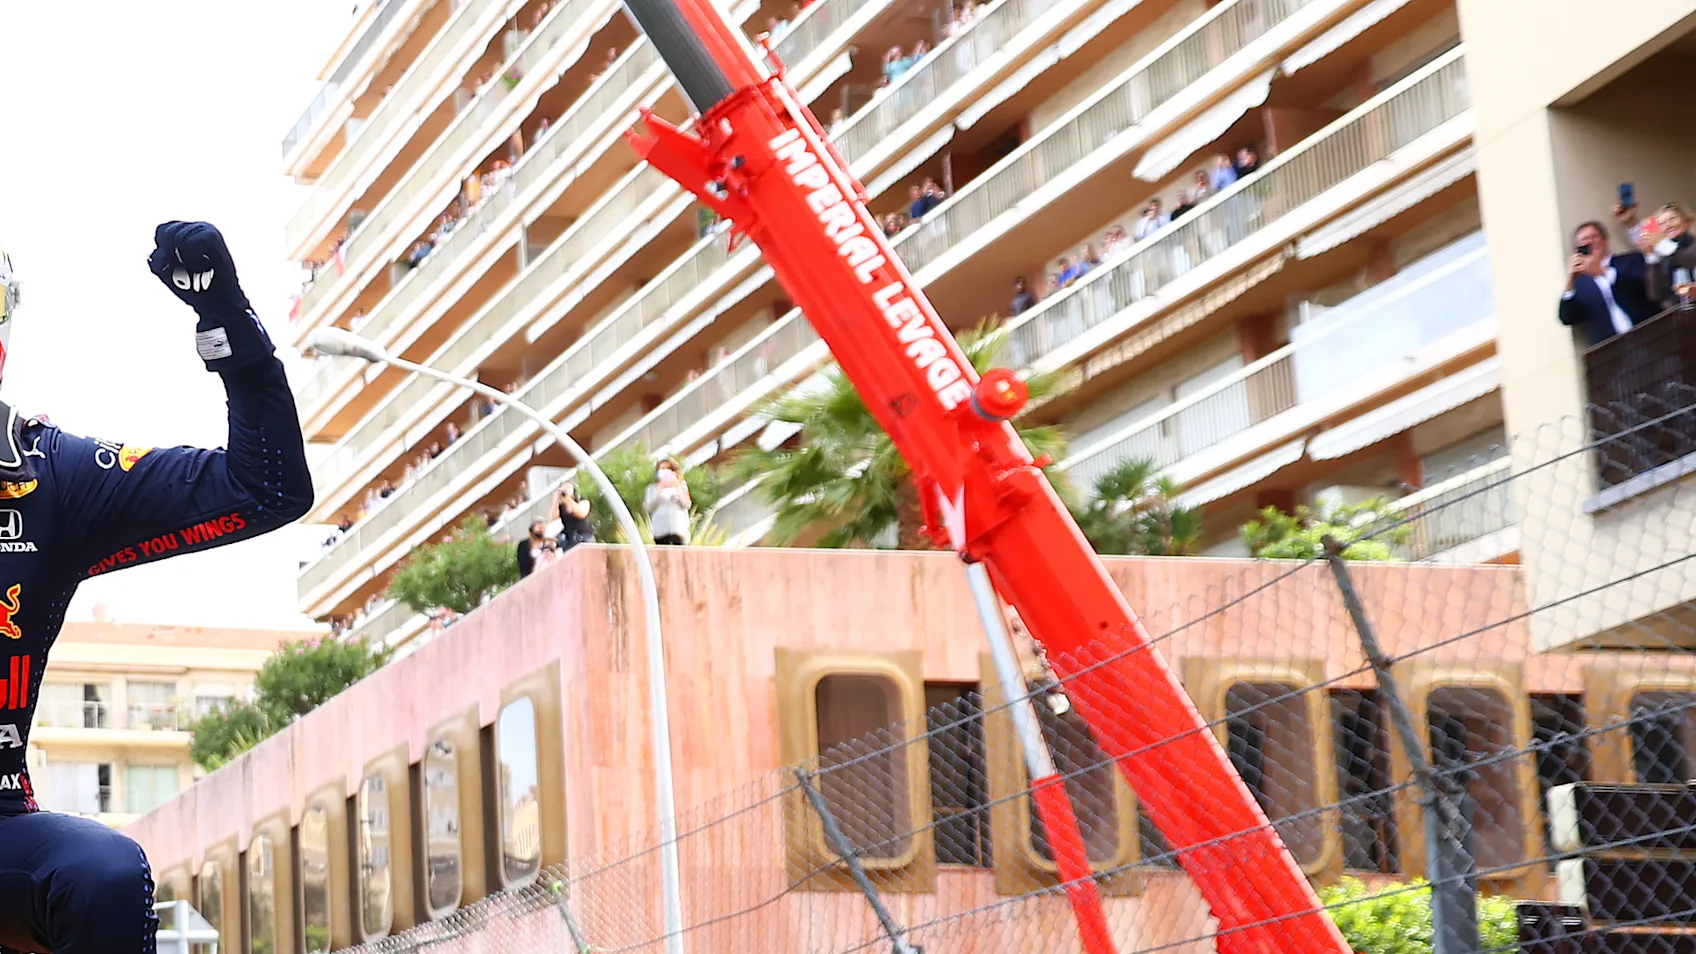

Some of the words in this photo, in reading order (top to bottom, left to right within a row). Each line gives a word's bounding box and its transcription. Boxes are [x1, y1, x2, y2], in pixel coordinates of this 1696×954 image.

[768, 129, 886, 285] IMPERIAL
[871, 278, 971, 410] LEVAGE
[88, 546, 138, 576] GIVES
[138, 532, 179, 558] YOU
[180, 512, 247, 546] WINGS
